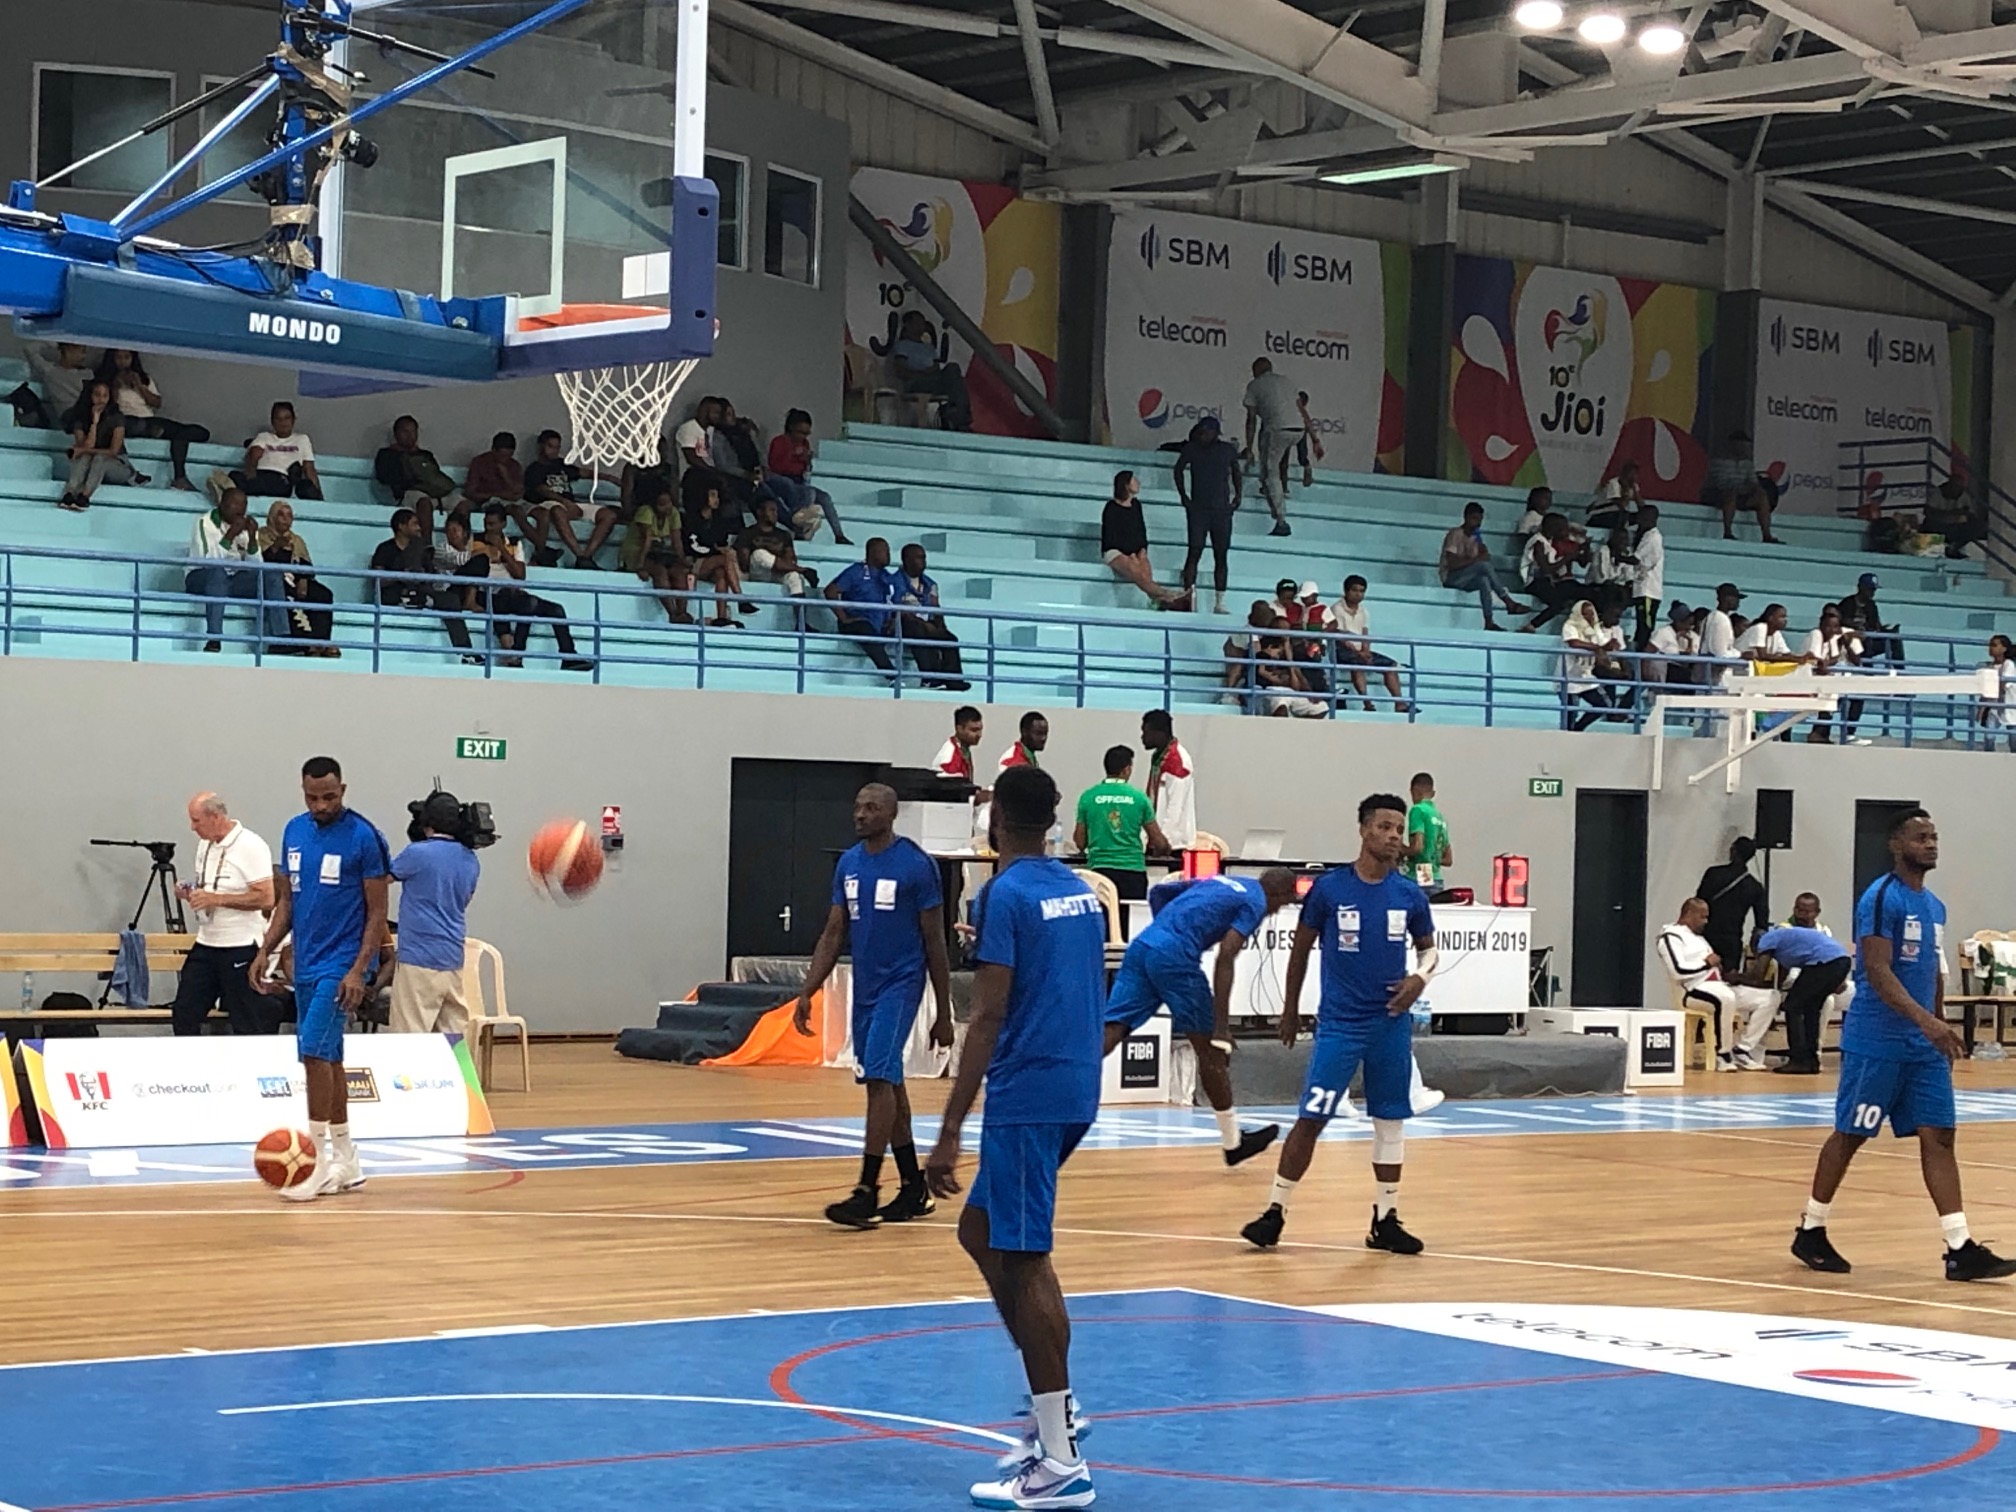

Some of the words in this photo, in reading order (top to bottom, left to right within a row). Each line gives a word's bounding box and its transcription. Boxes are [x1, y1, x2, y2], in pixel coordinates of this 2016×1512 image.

[1168, 238, 1229, 269] SBM
[1293, 254, 1352, 285] SBM
[249, 312, 341, 345] MONDO
[1139, 315, 1226, 347] telecom
[1792, 326, 1840, 354] SBM
[1265, 330, 1349, 360] telecom
[1888, 340, 1936, 366] SBM
[1767, 395, 1838, 423] telecom
[1865, 407, 1932, 433] telecom
[1791, 473, 1834, 490] pepsi
[463, 740, 500, 757] EXIT
[1095, 795, 1135, 804] OFFICIAL
[1533, 780, 1560, 794] EXIT
[1436, 931, 1487, 951] INDIEN
[1492, 932, 1527, 951] 2019
[1127, 1042, 1154, 1060] FIBA
[1646, 1033, 1671, 1048] FIBA
[82, 1102, 108, 1110] KFC
[1305, 1086, 1337, 1115] 21
[1854, 1103, 1881, 1129] 10
[1451, 1312, 1733, 1360] telecom
